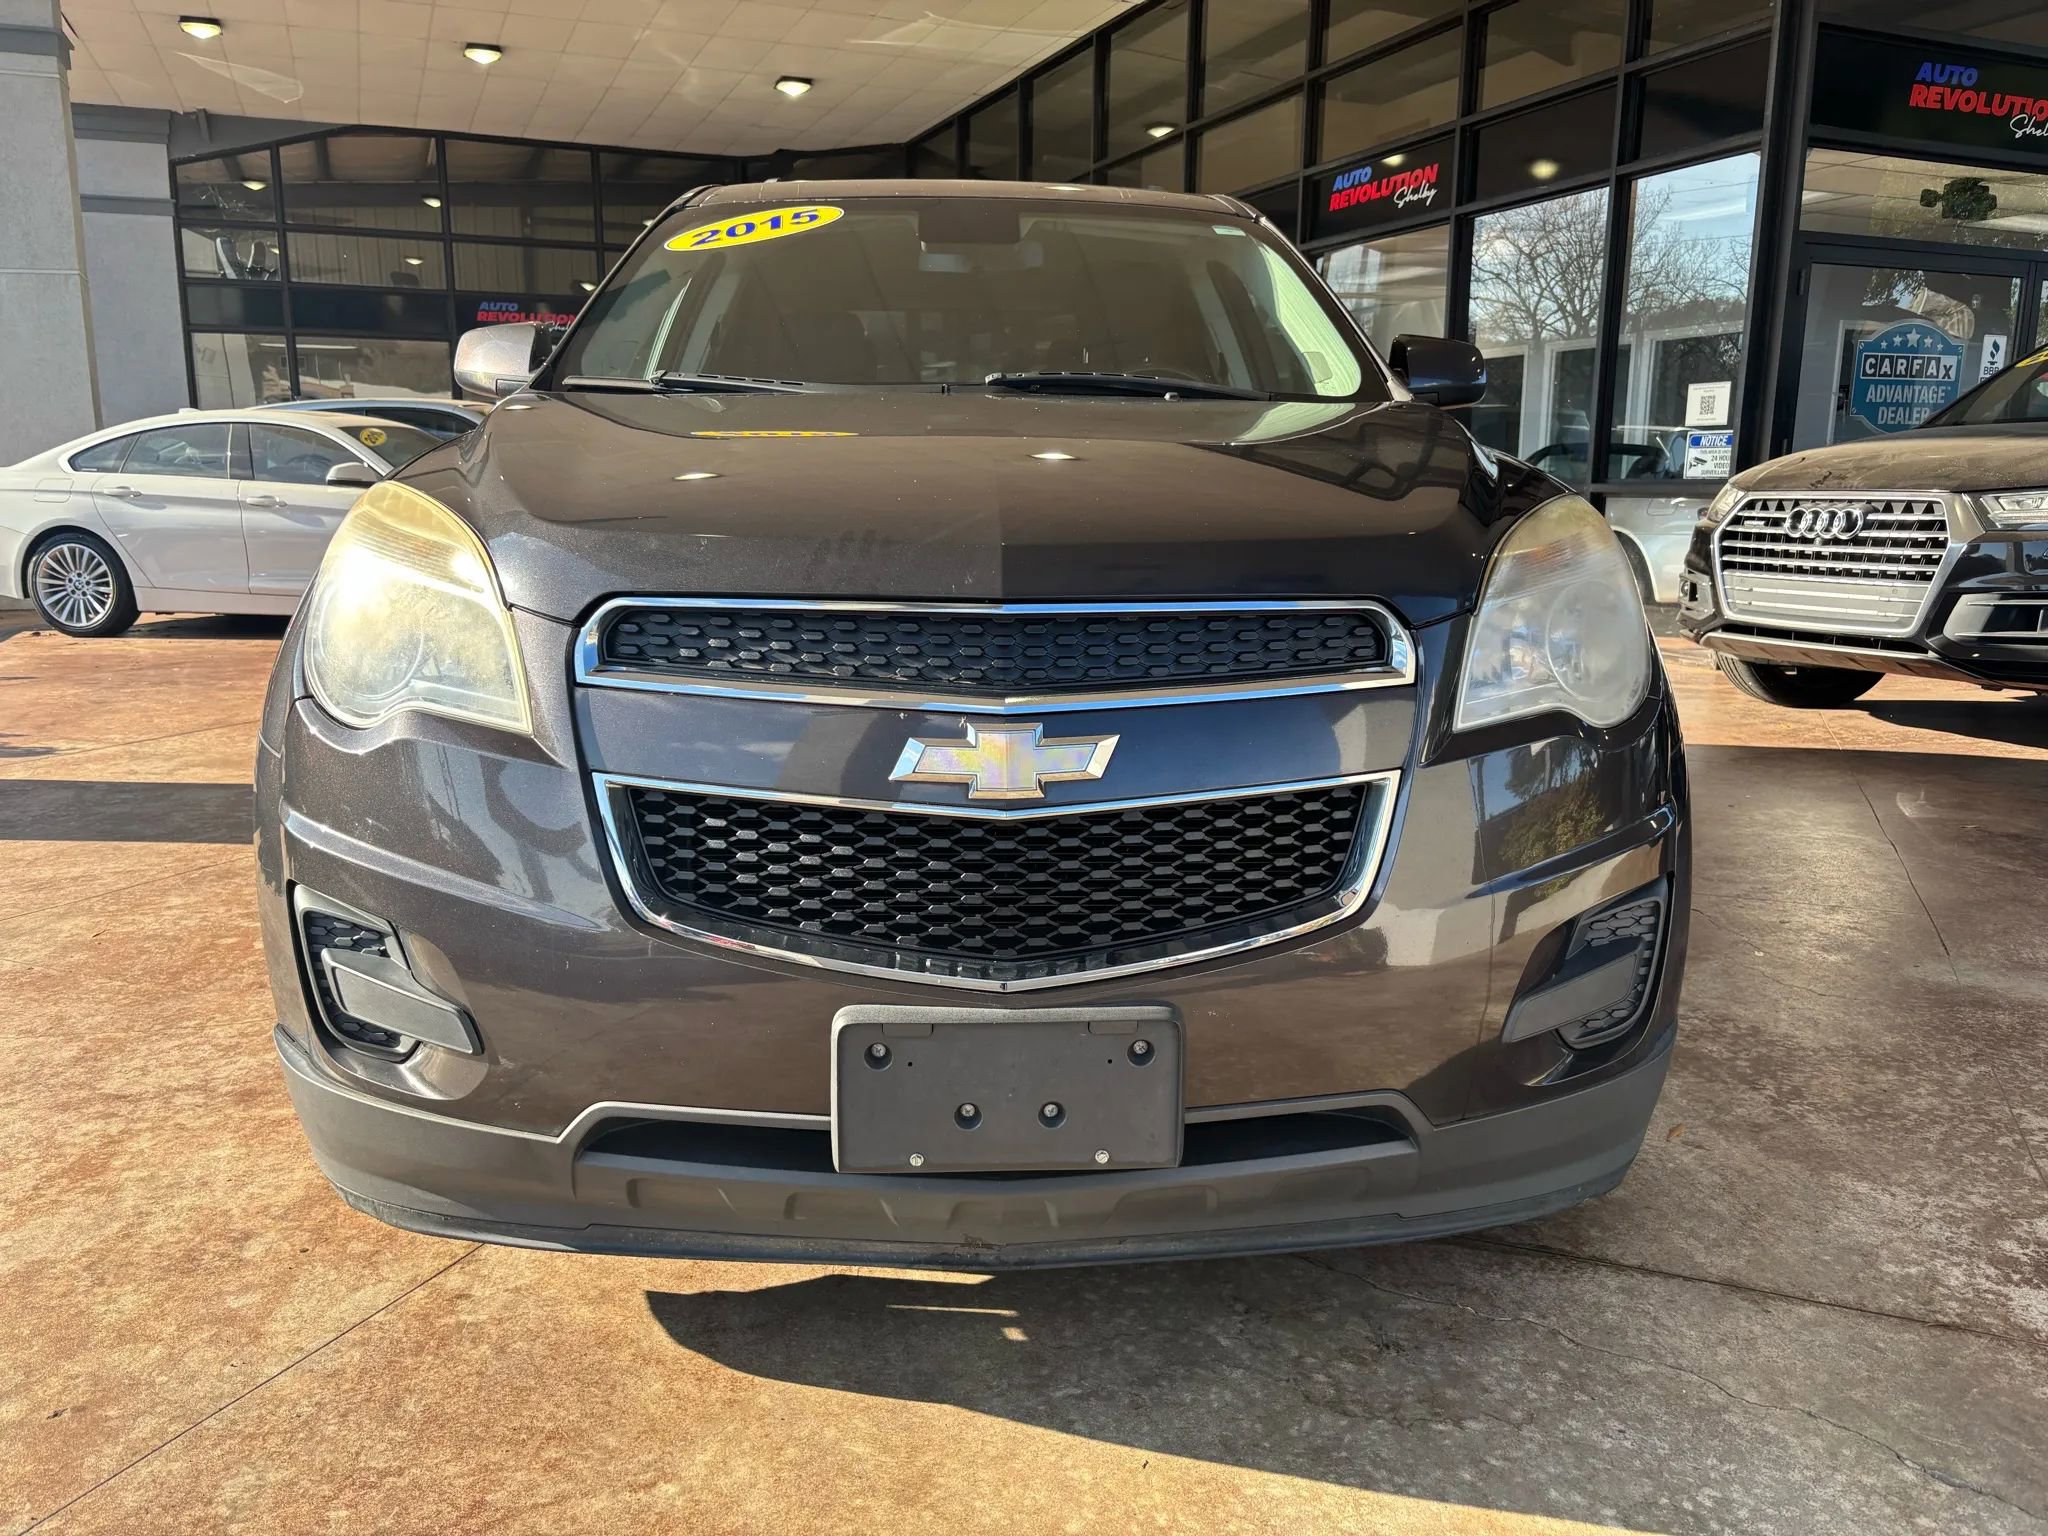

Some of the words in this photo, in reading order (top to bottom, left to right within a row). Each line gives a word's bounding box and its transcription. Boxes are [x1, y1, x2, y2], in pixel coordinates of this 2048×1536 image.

[1915, 62, 1979, 87] AUTO
[1329, 163, 1439, 211] REVOLUTION
[1333, 166, 1372, 191] AUTO
[1394, 180, 1437, 208] Shelby
[690, 209, 820, 248] 2015
[479, 302, 518, 312] AUTO
[1864, 357, 1954, 380] CARFAX
[1865, 384, 1946, 404] ADVANTAGE
[1877, 406, 1931, 425] DEALER
[1700, 435, 1729, 446] NOTICE
